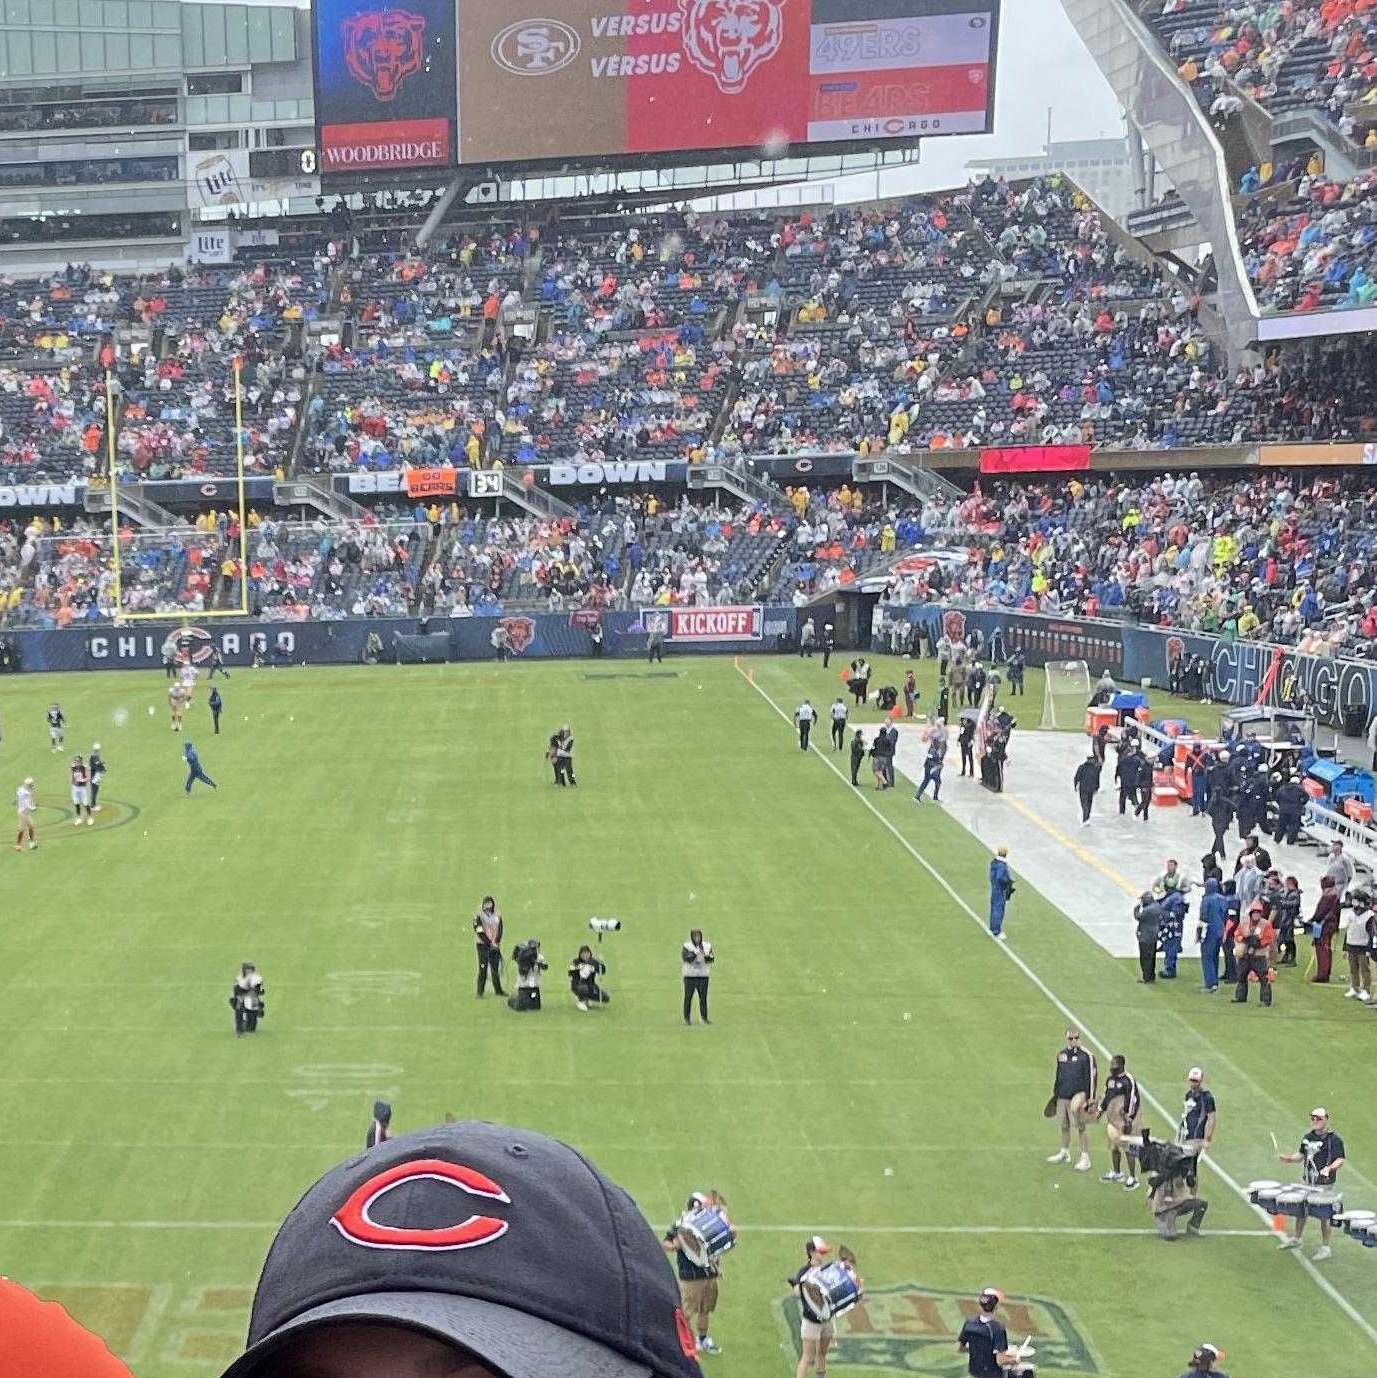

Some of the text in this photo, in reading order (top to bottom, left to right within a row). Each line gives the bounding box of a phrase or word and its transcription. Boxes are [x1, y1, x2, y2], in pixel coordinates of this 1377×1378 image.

[590, 12, 682, 37] VERSUS
[816, 26, 920, 62] 49ERS
[590, 52, 680, 78] VERSUS
[815, 83, 930, 117] BEARS
[326, 141, 443, 164] WOODBRIDGE
[198, 236, 225, 250] Lite
[477, 475, 499, 494] 34
[548, 462, 666, 485] DOWN
[677, 612, 748, 636] KICKOFF
[329, 1158, 512, 1252] C
